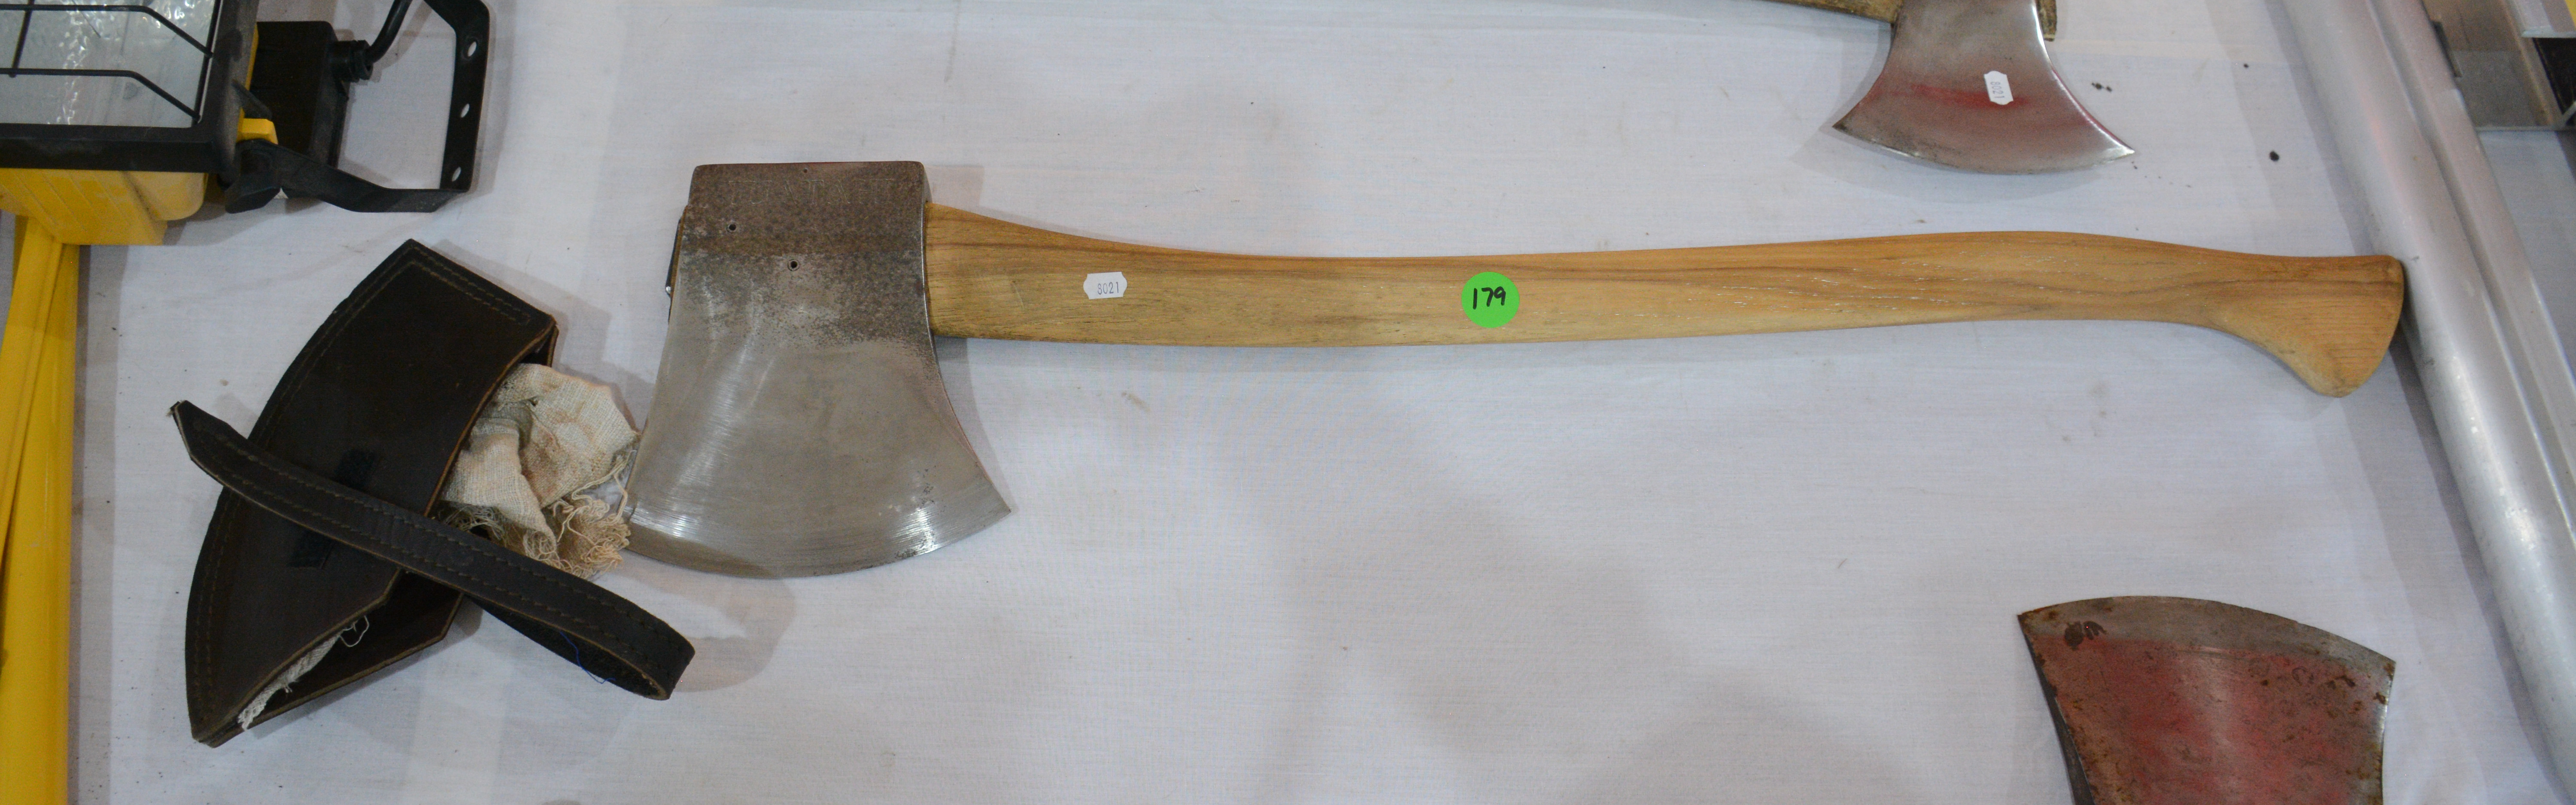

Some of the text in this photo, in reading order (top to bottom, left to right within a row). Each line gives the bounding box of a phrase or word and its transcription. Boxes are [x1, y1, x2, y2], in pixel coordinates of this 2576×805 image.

[1990, 82, 2005, 98] 8021
[1097, 281, 1119, 295] 8021
[1472, 286, 1507, 310] 179
